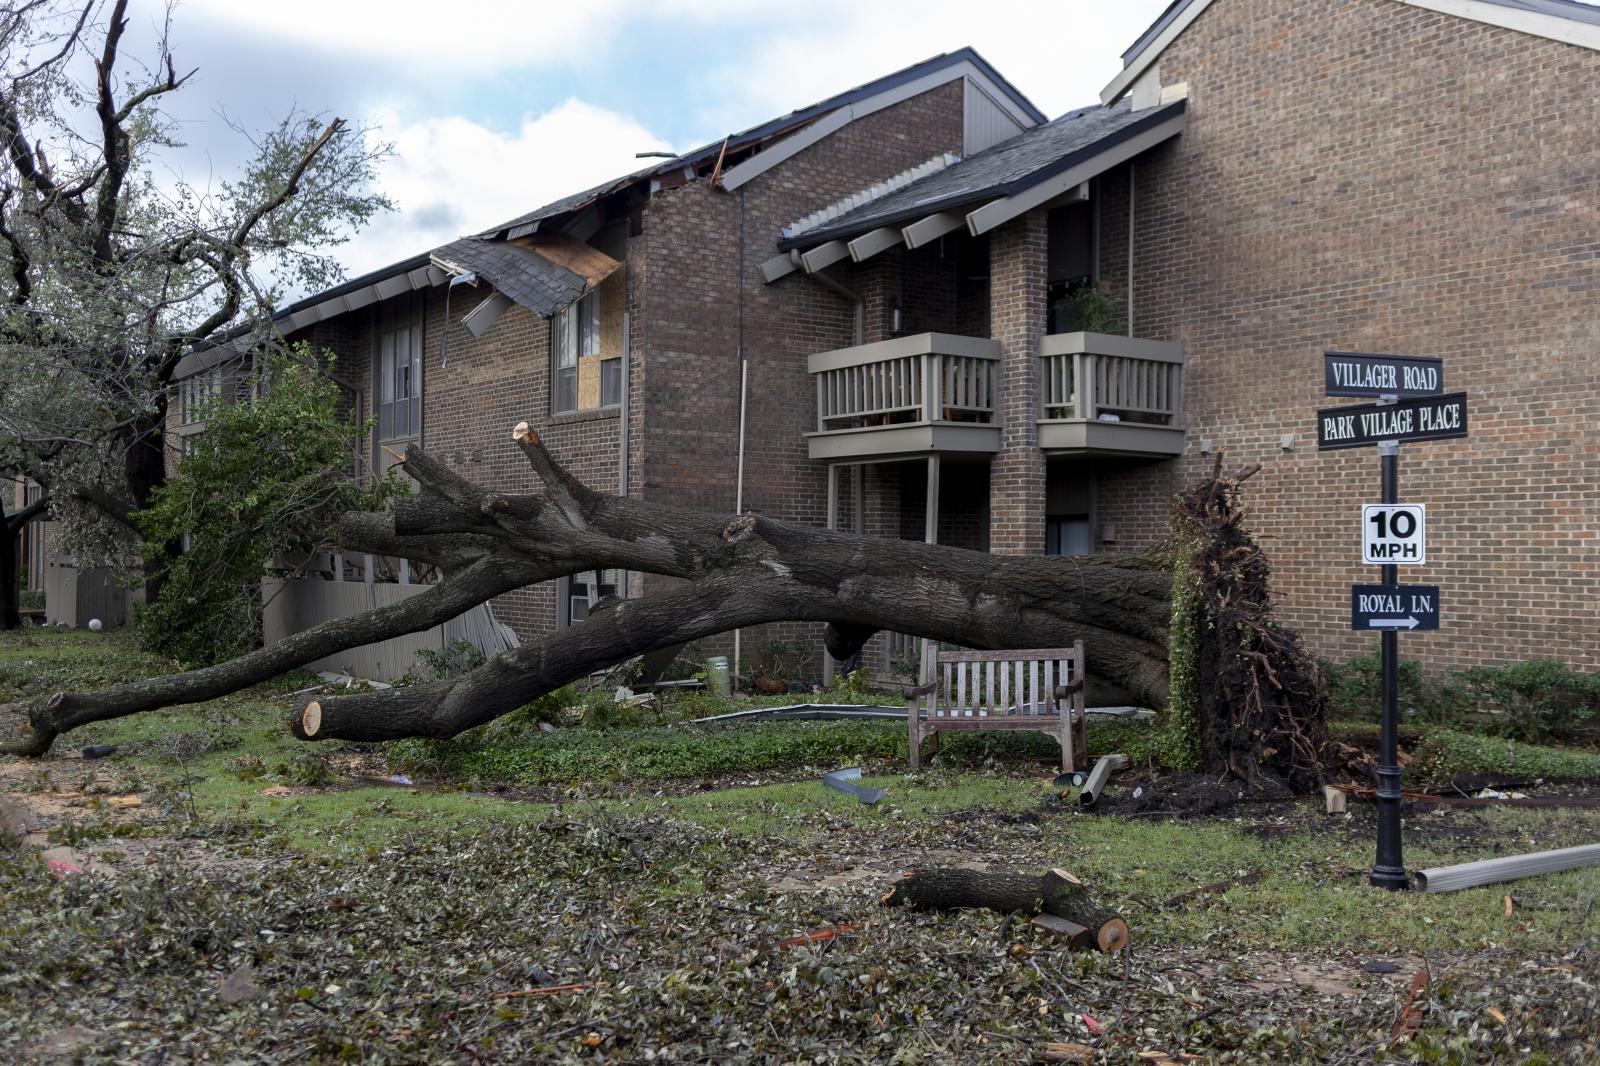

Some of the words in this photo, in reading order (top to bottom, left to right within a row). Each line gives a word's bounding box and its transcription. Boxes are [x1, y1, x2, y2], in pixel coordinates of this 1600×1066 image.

[1332, 362, 1398, 389] VILLAGER
[1403, 366, 1438, 391] ROAD
[1323, 415, 1355, 441] PARK
[1360, 409, 1413, 437] VILLAGE
[1419, 403, 1460, 431] PLACE
[1370, 510, 1417, 539] 10
[1370, 543, 1417, 558] MPH
[1358, 594, 1405, 613] ROYAL
[1411, 595, 1434, 613] LN.
